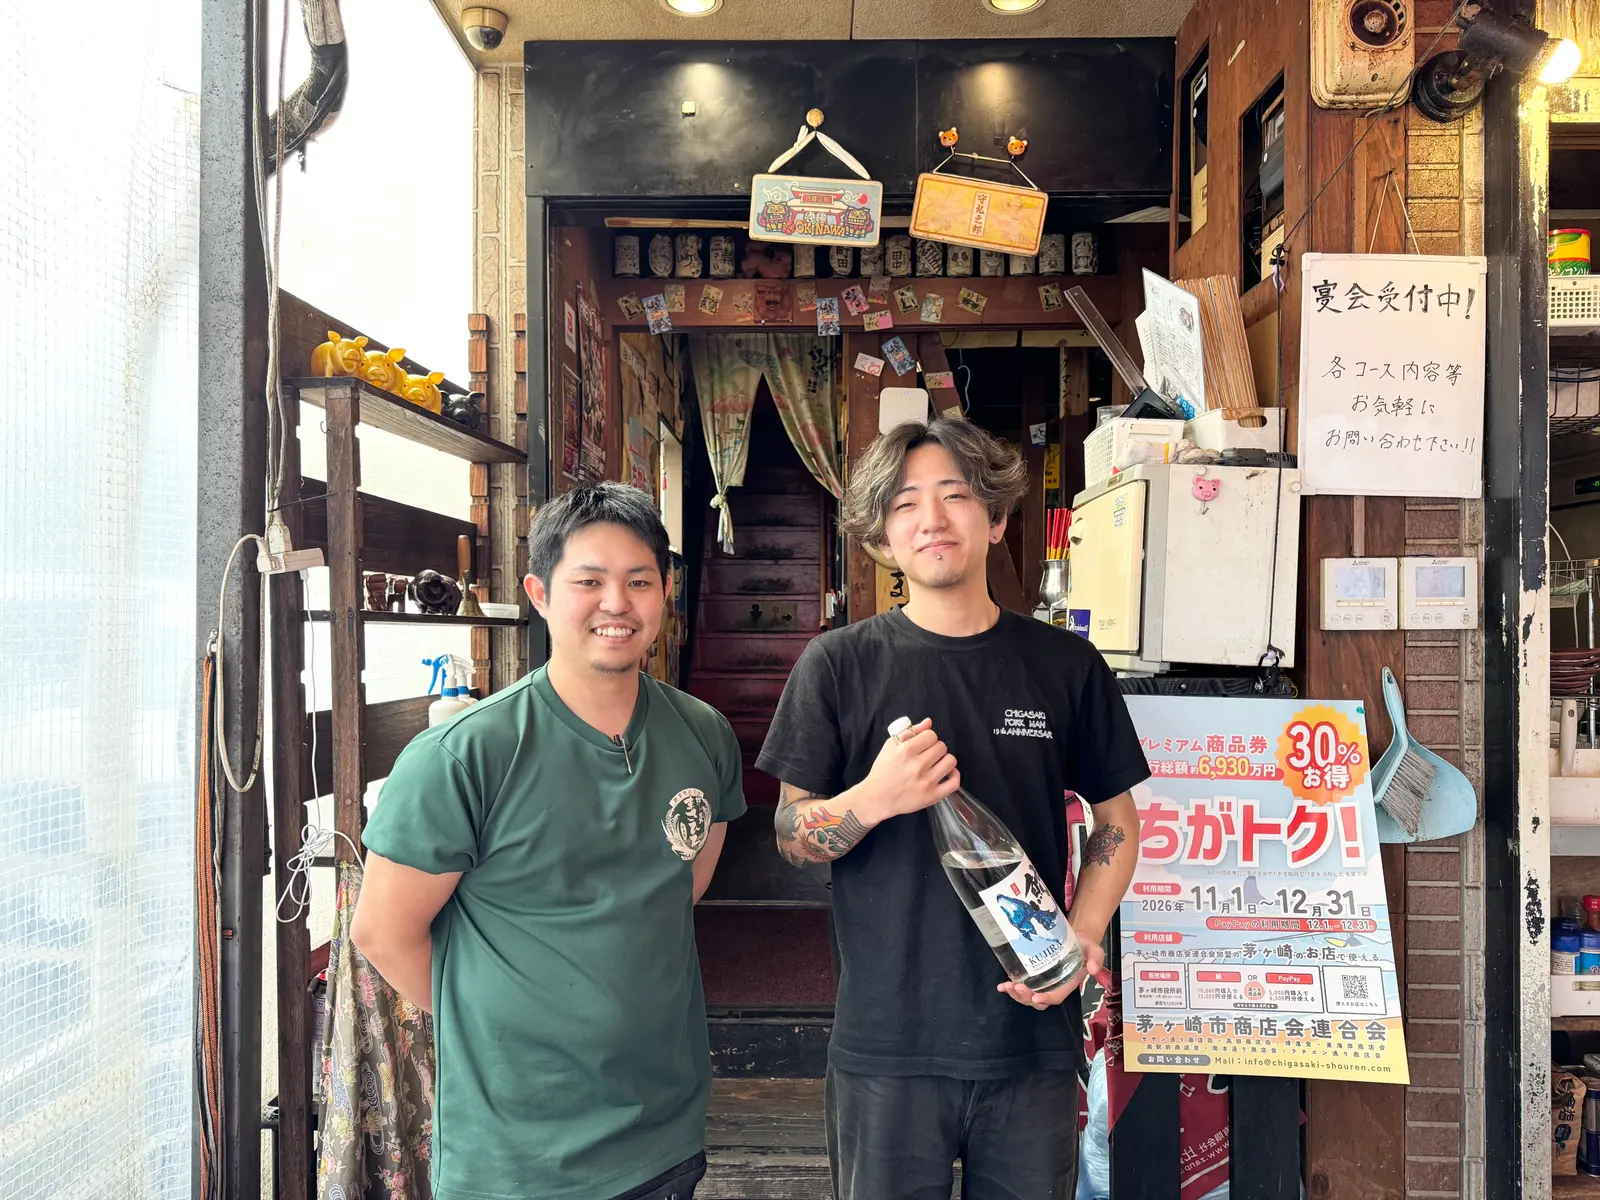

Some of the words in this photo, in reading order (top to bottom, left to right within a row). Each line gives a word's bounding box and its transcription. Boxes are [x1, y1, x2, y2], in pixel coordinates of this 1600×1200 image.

[969, 192, 988, 236] 守礼之邦
[891, 250, 903, 270] 田中
[1312, 279, 1476, 320] 宴会受付中!
[1321, 355, 1463, 386] 各コース内容等
[1351, 394, 1436, 417] お気軽に
[1006, 728, 1053, 739] ANNIVERSAR
[1288, 724, 1362, 770] 30%
[1302, 764, 1350, 790] お得
[1141, 884, 1172, 893] 利用期間
[1141, 899, 1185, 913] 2026年
[1214, 919, 1301, 930] PayPayの利用期間
[1143, 933, 1173, 942] 利用店舗
[1028, 940, 1064, 966] KUJIRA
[1278, 975, 1301, 983] PayPay
[1136, 1014, 1388, 1042] 茅ヶ崎市商店会連合会
[1148, 1055, 1200, 1064] お問い合わせ
[1244, 1057, 1392, 1073] info@chigasaki-shouren.com
